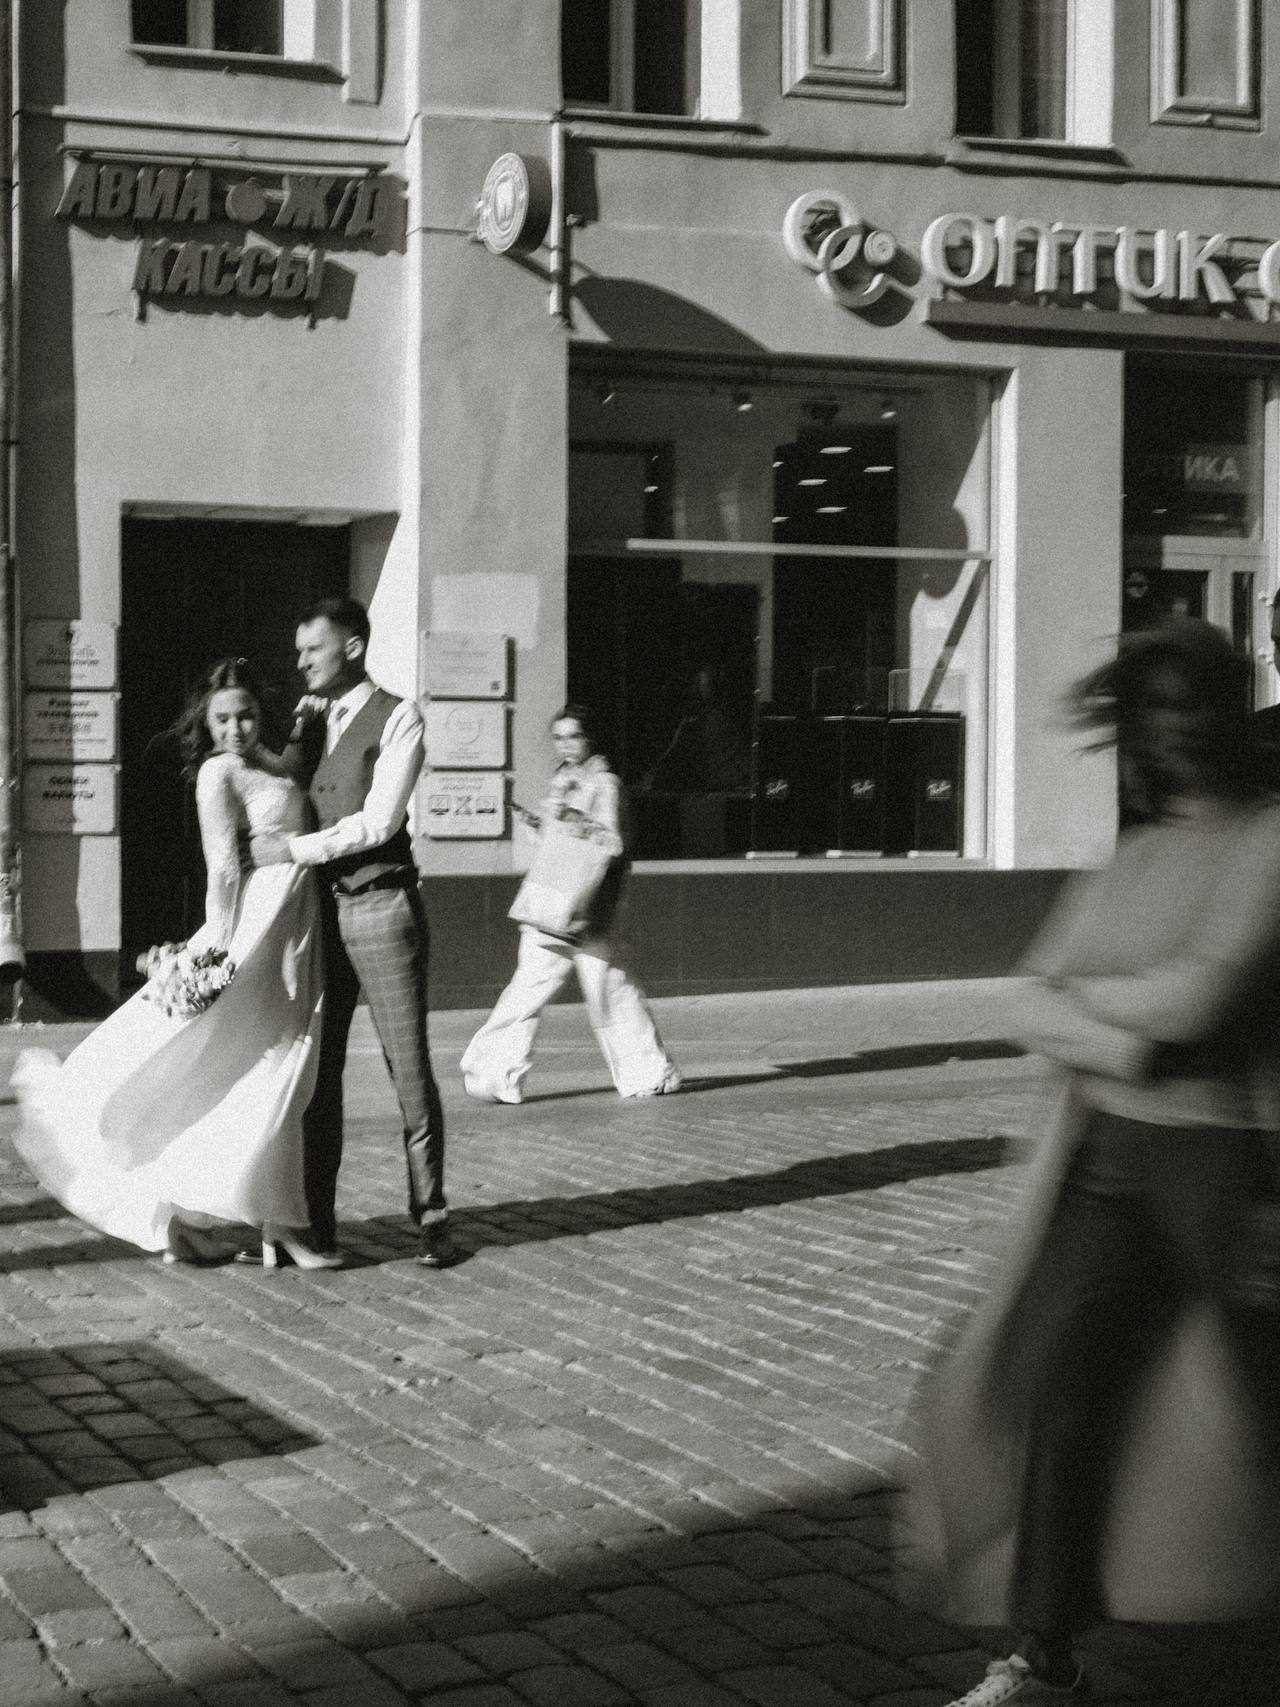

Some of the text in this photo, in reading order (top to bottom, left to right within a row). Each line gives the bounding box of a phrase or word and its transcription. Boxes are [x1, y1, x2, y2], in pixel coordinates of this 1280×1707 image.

[55, 162, 392, 239] АВИА Ж/Д
[132, 236, 324, 301] КАССЫ
